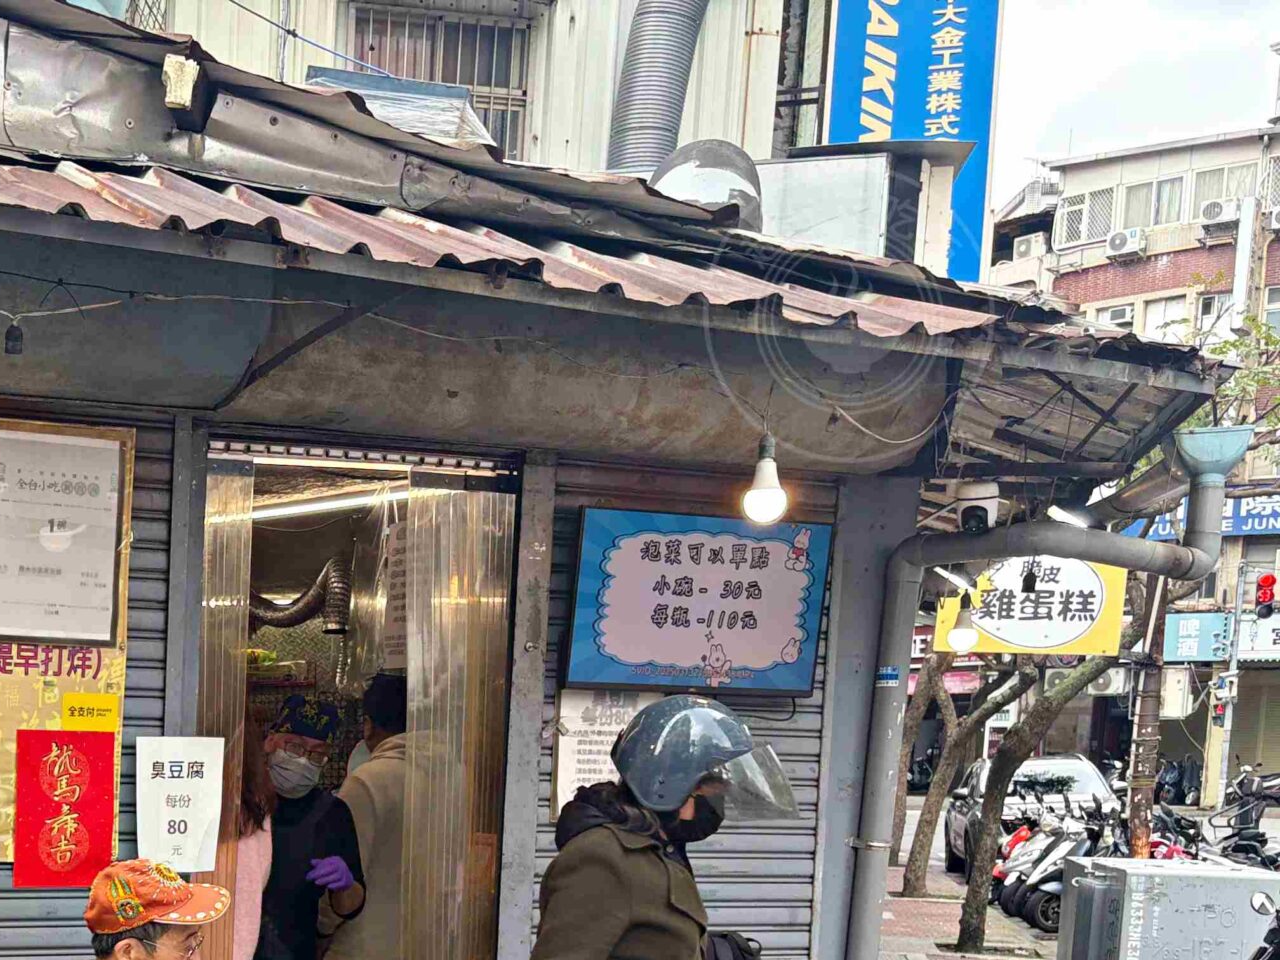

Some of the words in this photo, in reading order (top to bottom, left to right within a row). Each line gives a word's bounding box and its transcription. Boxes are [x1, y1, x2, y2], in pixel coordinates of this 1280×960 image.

[924, 0, 968, 141] 大金工業株式
[640, 539, 770, 570] 泡菜可以單點
[979, 588, 1097, 623] 雞蛋糕
[67, 705, 95, 718] 全支付
[151, 761, 205, 780] 臭豆腐
[166, 794, 192, 809] 每份
[167, 819, 188, 835] 80
[171, 845, 183, 856] 元
